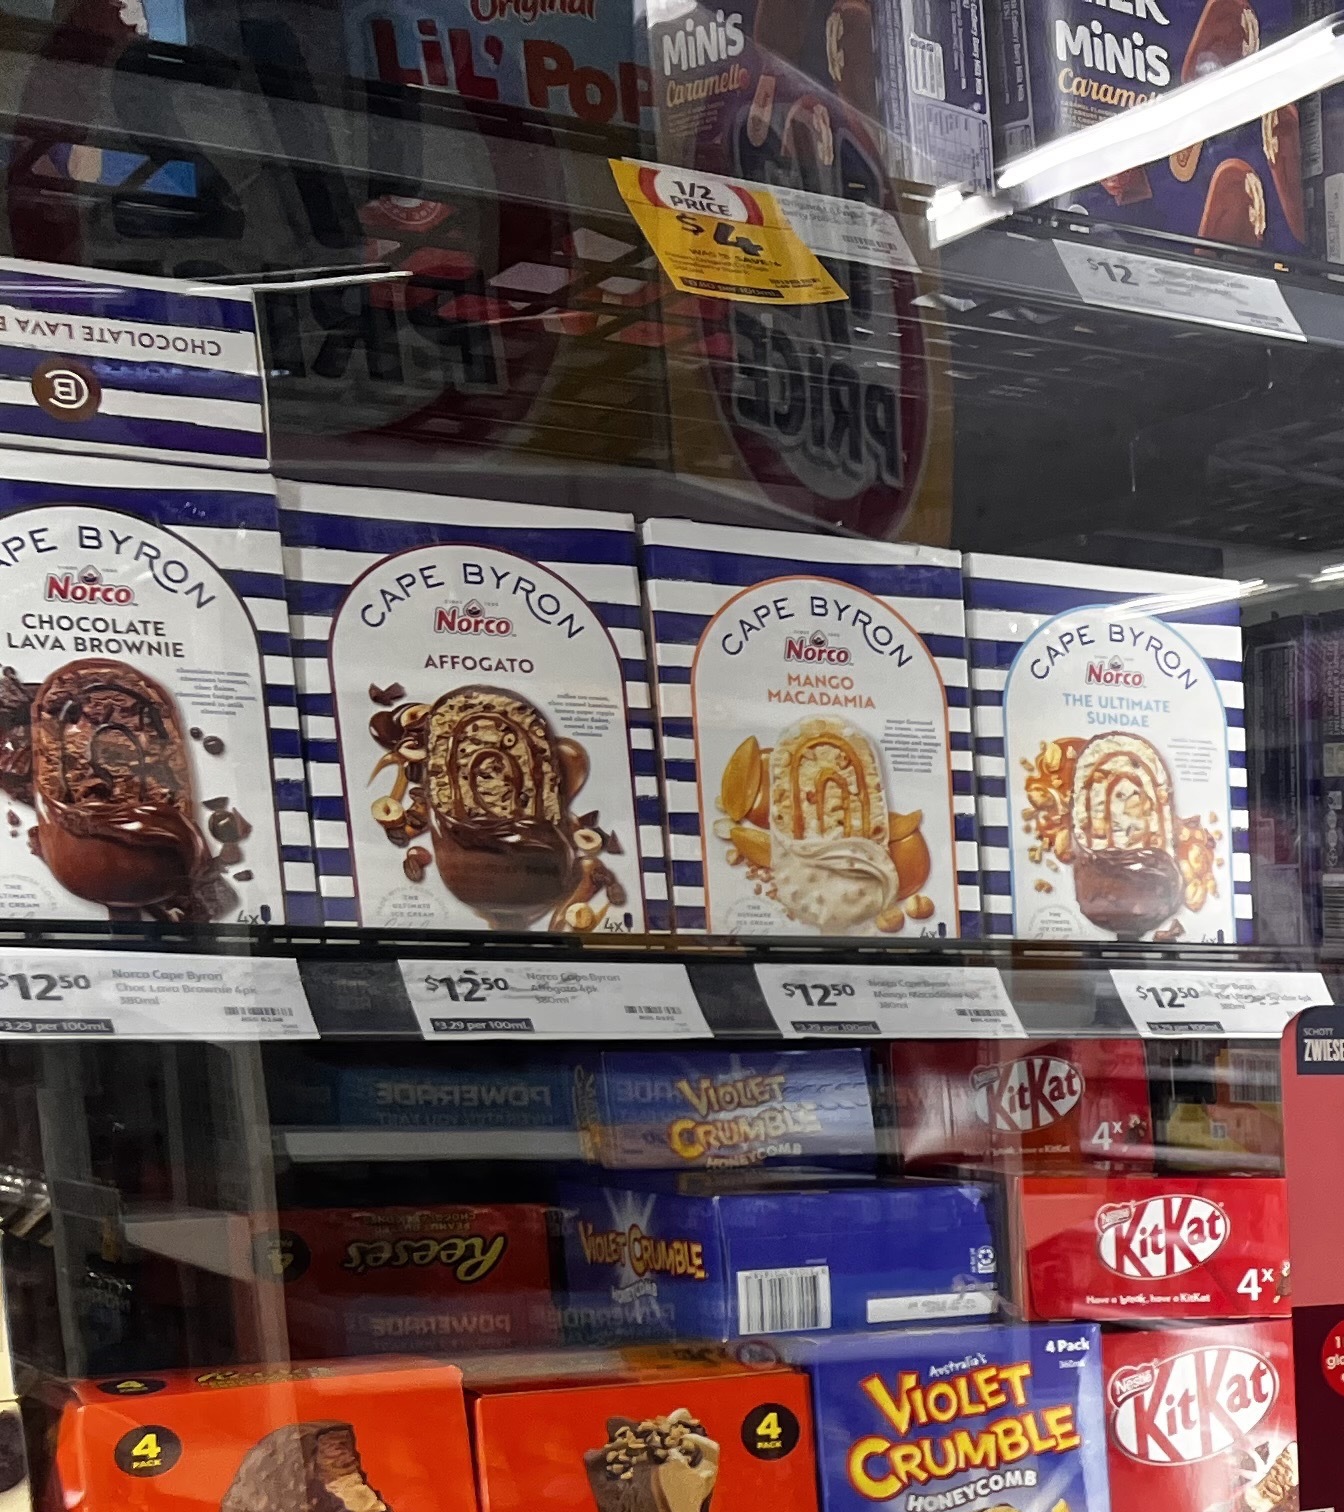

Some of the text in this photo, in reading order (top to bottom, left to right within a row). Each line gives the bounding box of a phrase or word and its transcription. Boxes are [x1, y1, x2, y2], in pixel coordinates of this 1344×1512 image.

[77, 524, 217, 611] BYRON
[46, 572, 133, 606] Norco
[360, 559, 586, 641] CAPE BYRON
[21, 612, 167, 639] CHOCOLATE
[720, 594, 914, 670] CAPE BYRON
[6, 633, 186, 660] LAVA BROWNIE
[1028, 622, 1200, 691] CAPE BYRON
[423, 653, 536, 675] AFFOGATO
[786, 671, 855, 691] MANGO
[766, 689, 877, 711] MACADAMIA
[1062, 692, 1172, 714] THE ULTIMATE
[1086, 710, 1151, 729] SUNDAE
[1303, 1027, 1334, 1036] SCHOTT
[1113, 1197, 1223, 1278] KitKat
[1058, 1337, 1091, 1353] Pack
[861, 1362, 1031, 1436] VIOLET
[1133, 1347, 1273, 1464] KitKat
[847, 1404, 1083, 1500] CRUMBLE
